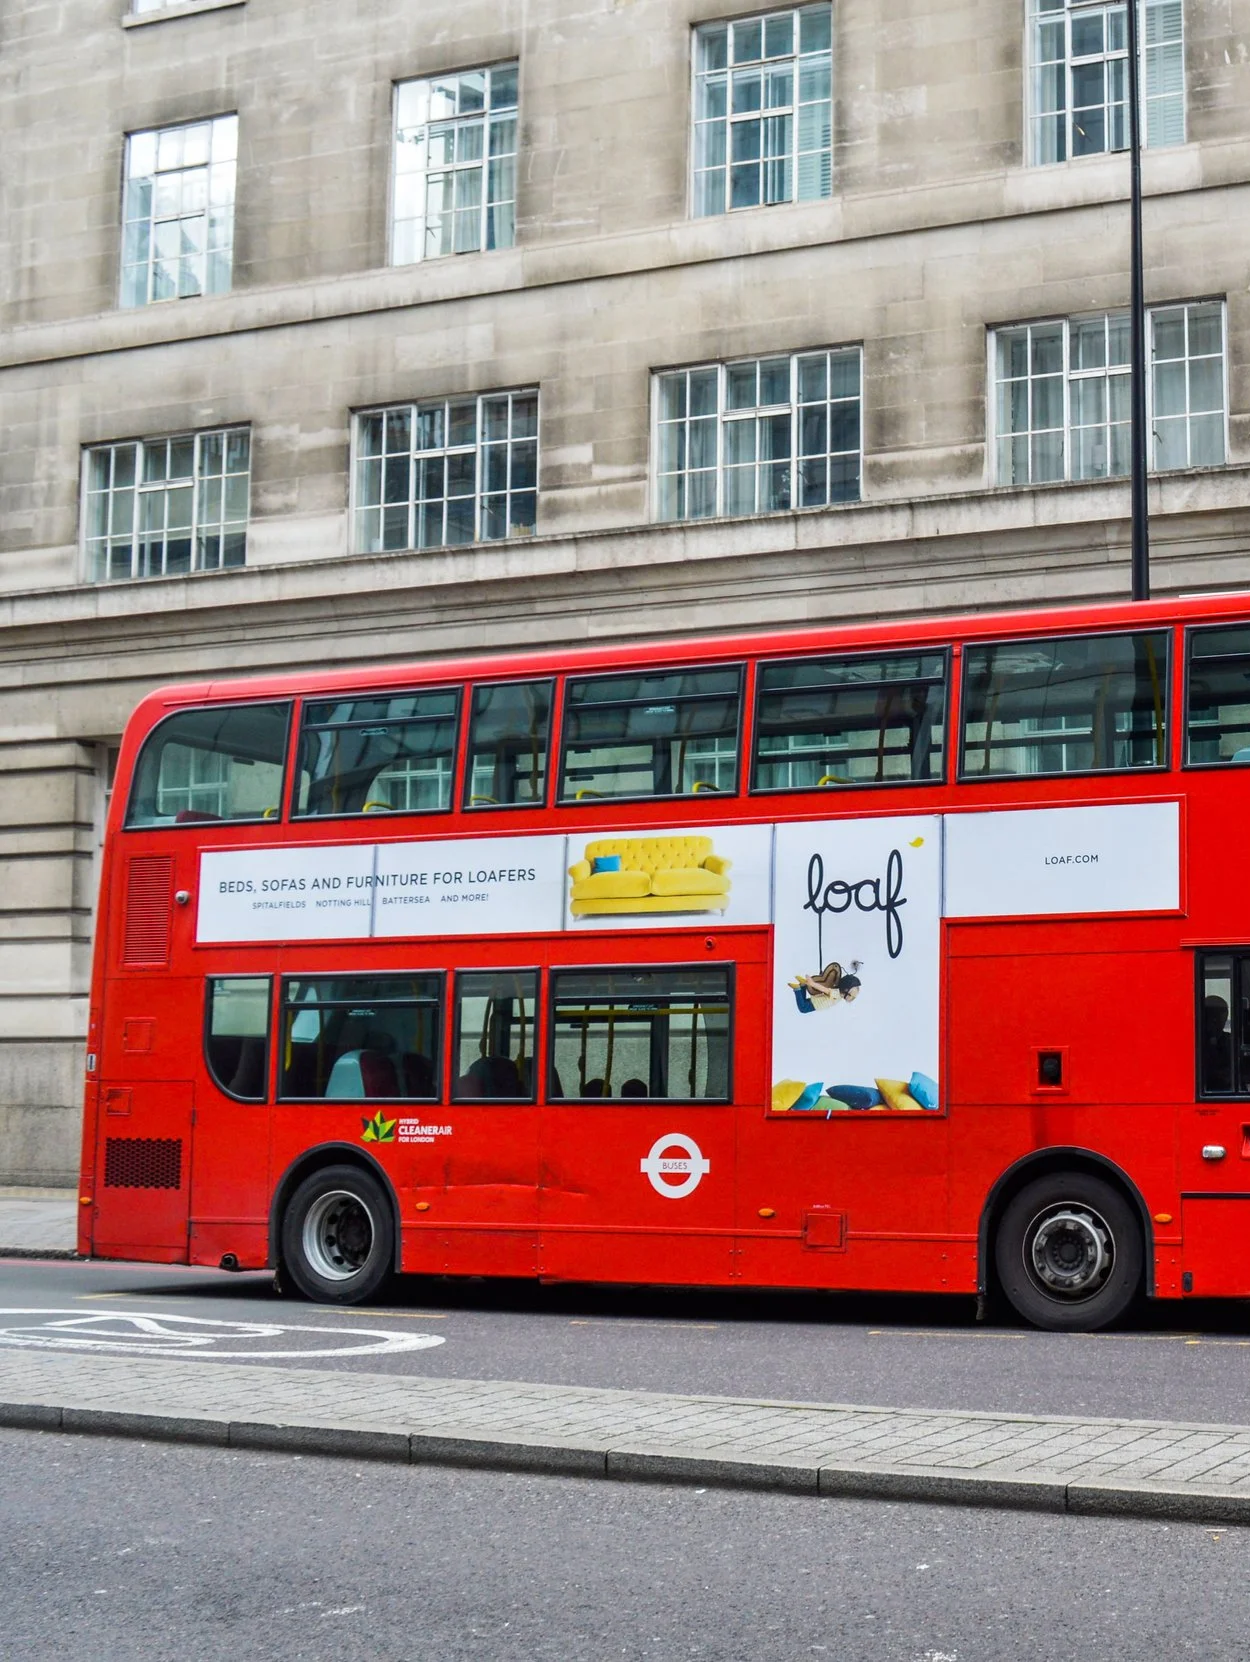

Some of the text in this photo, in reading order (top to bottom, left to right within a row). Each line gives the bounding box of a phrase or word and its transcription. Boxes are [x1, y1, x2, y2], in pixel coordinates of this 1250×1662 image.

[1044, 854, 1099, 866] LOAF.COM
[219, 868, 537, 894] BEDS, SOFAS AND FURNITURE FOR LOAFERS
[252, 892, 489, 910] SPITALFIELDS NOTTING HILL BATTERSEA AND MORE!
[803, 848, 908, 959] loaf
[662, 1161, 688, 1170] BUSES
